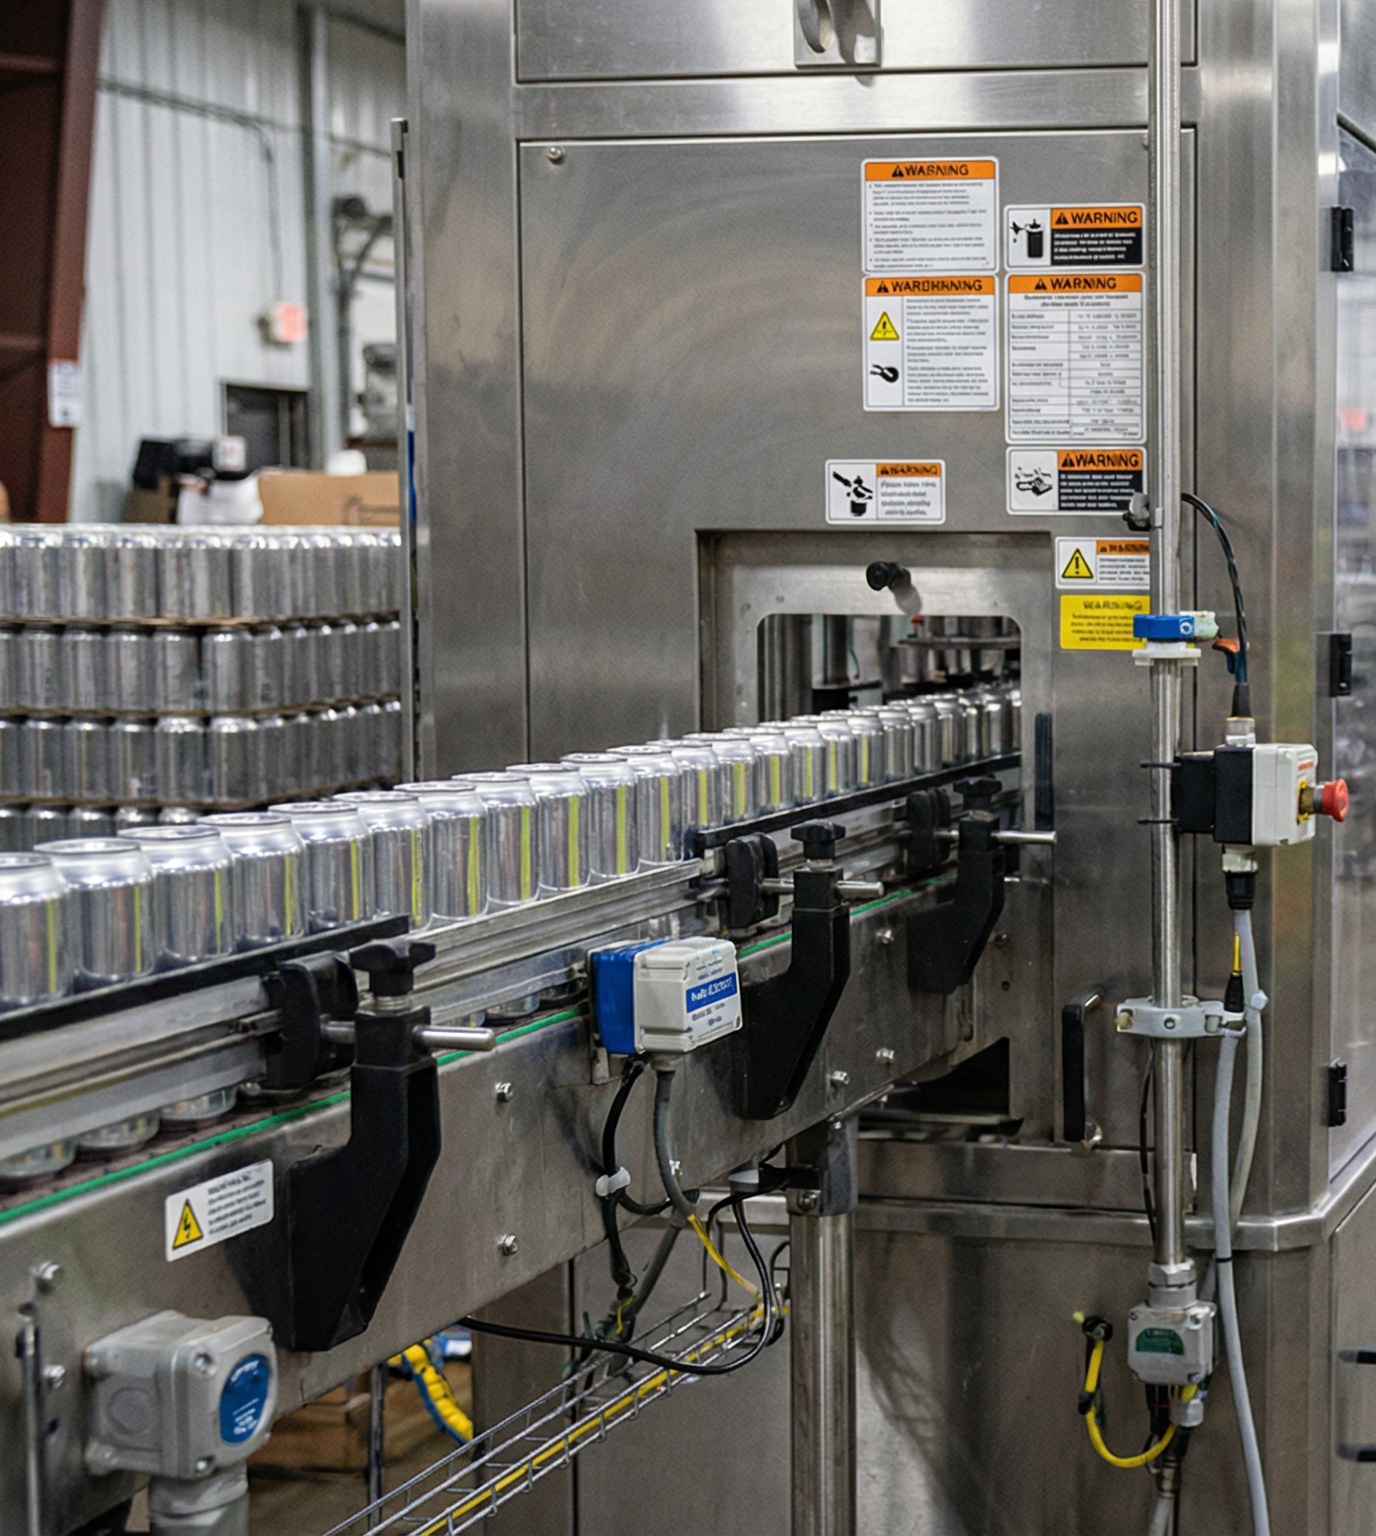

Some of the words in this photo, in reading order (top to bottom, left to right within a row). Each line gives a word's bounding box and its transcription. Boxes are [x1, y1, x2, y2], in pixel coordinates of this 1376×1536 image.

[1071, 211, 1138, 224] WARNING
[1050, 277, 1117, 290] WARNING
[1075, 453, 1139, 467] WARNING
